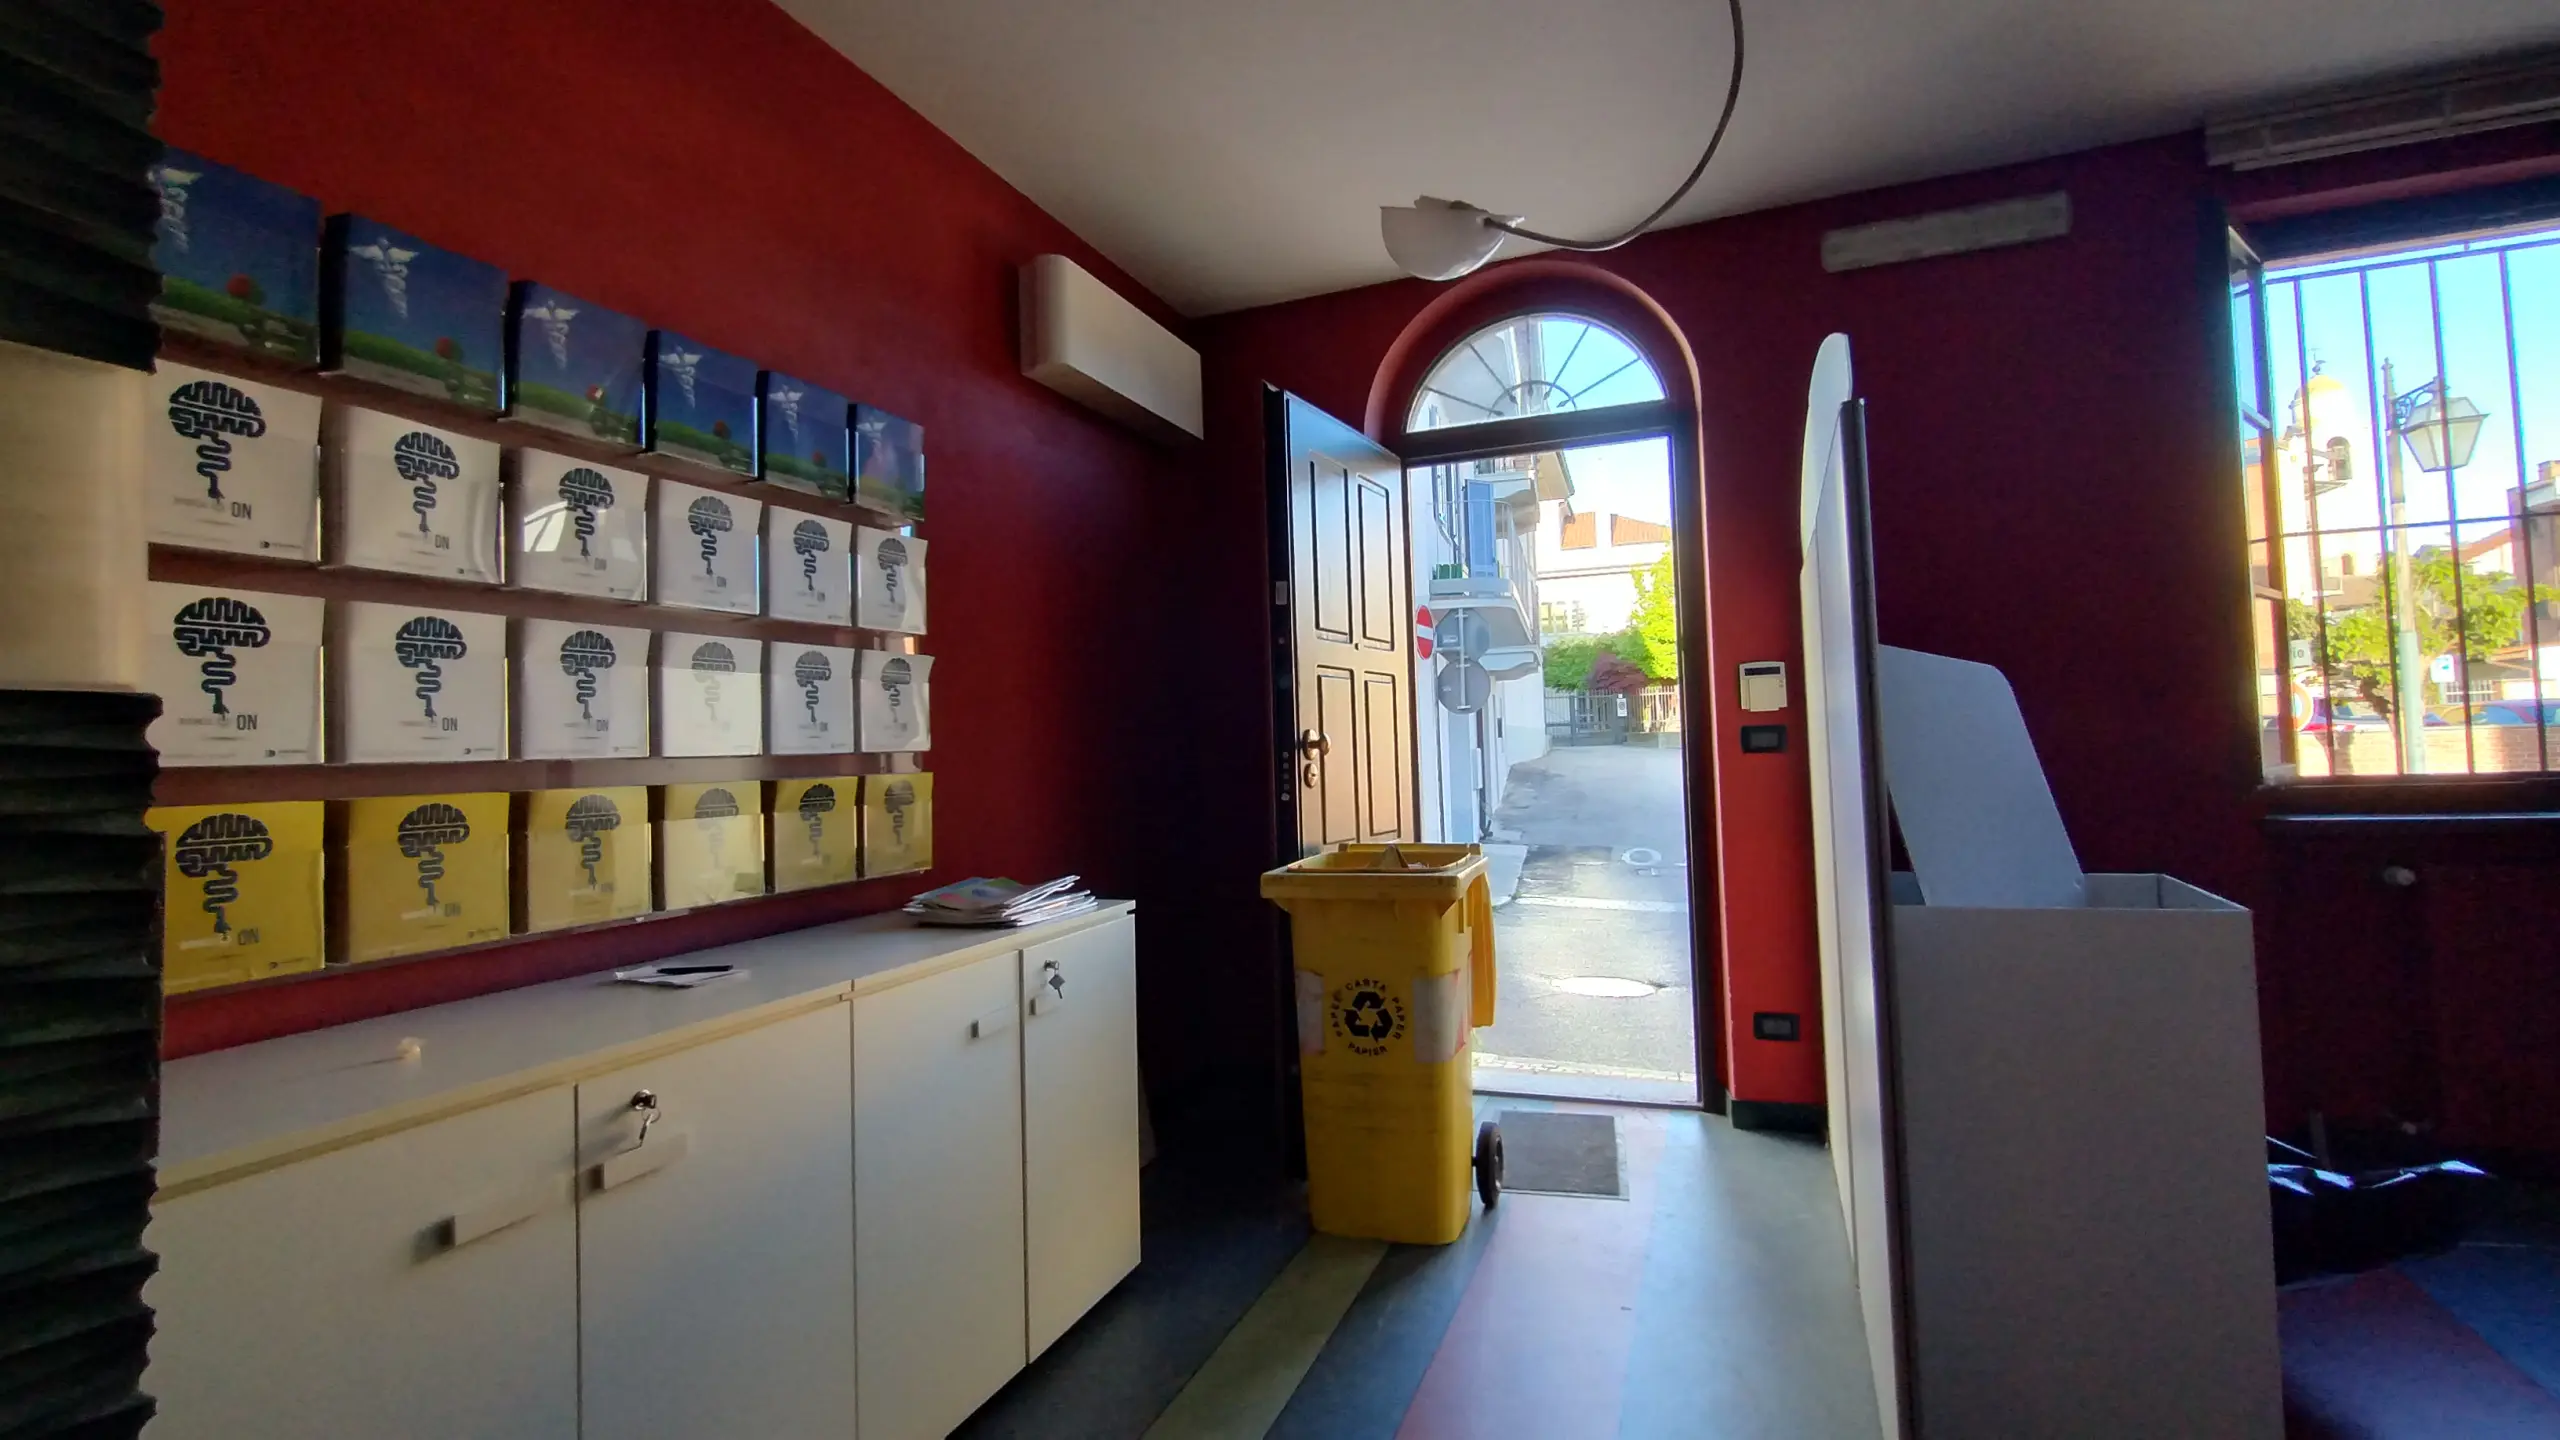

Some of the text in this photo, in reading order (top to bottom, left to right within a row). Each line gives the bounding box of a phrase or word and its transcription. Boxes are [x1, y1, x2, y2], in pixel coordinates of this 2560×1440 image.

[236, 714, 258, 730] ON
[442, 717, 458, 731] ON
[1345, 978, 1386, 993] CARTA
[1392, 997, 1405, 1040] PAPER
[1348, 1042, 1388, 1057] PAPIER
